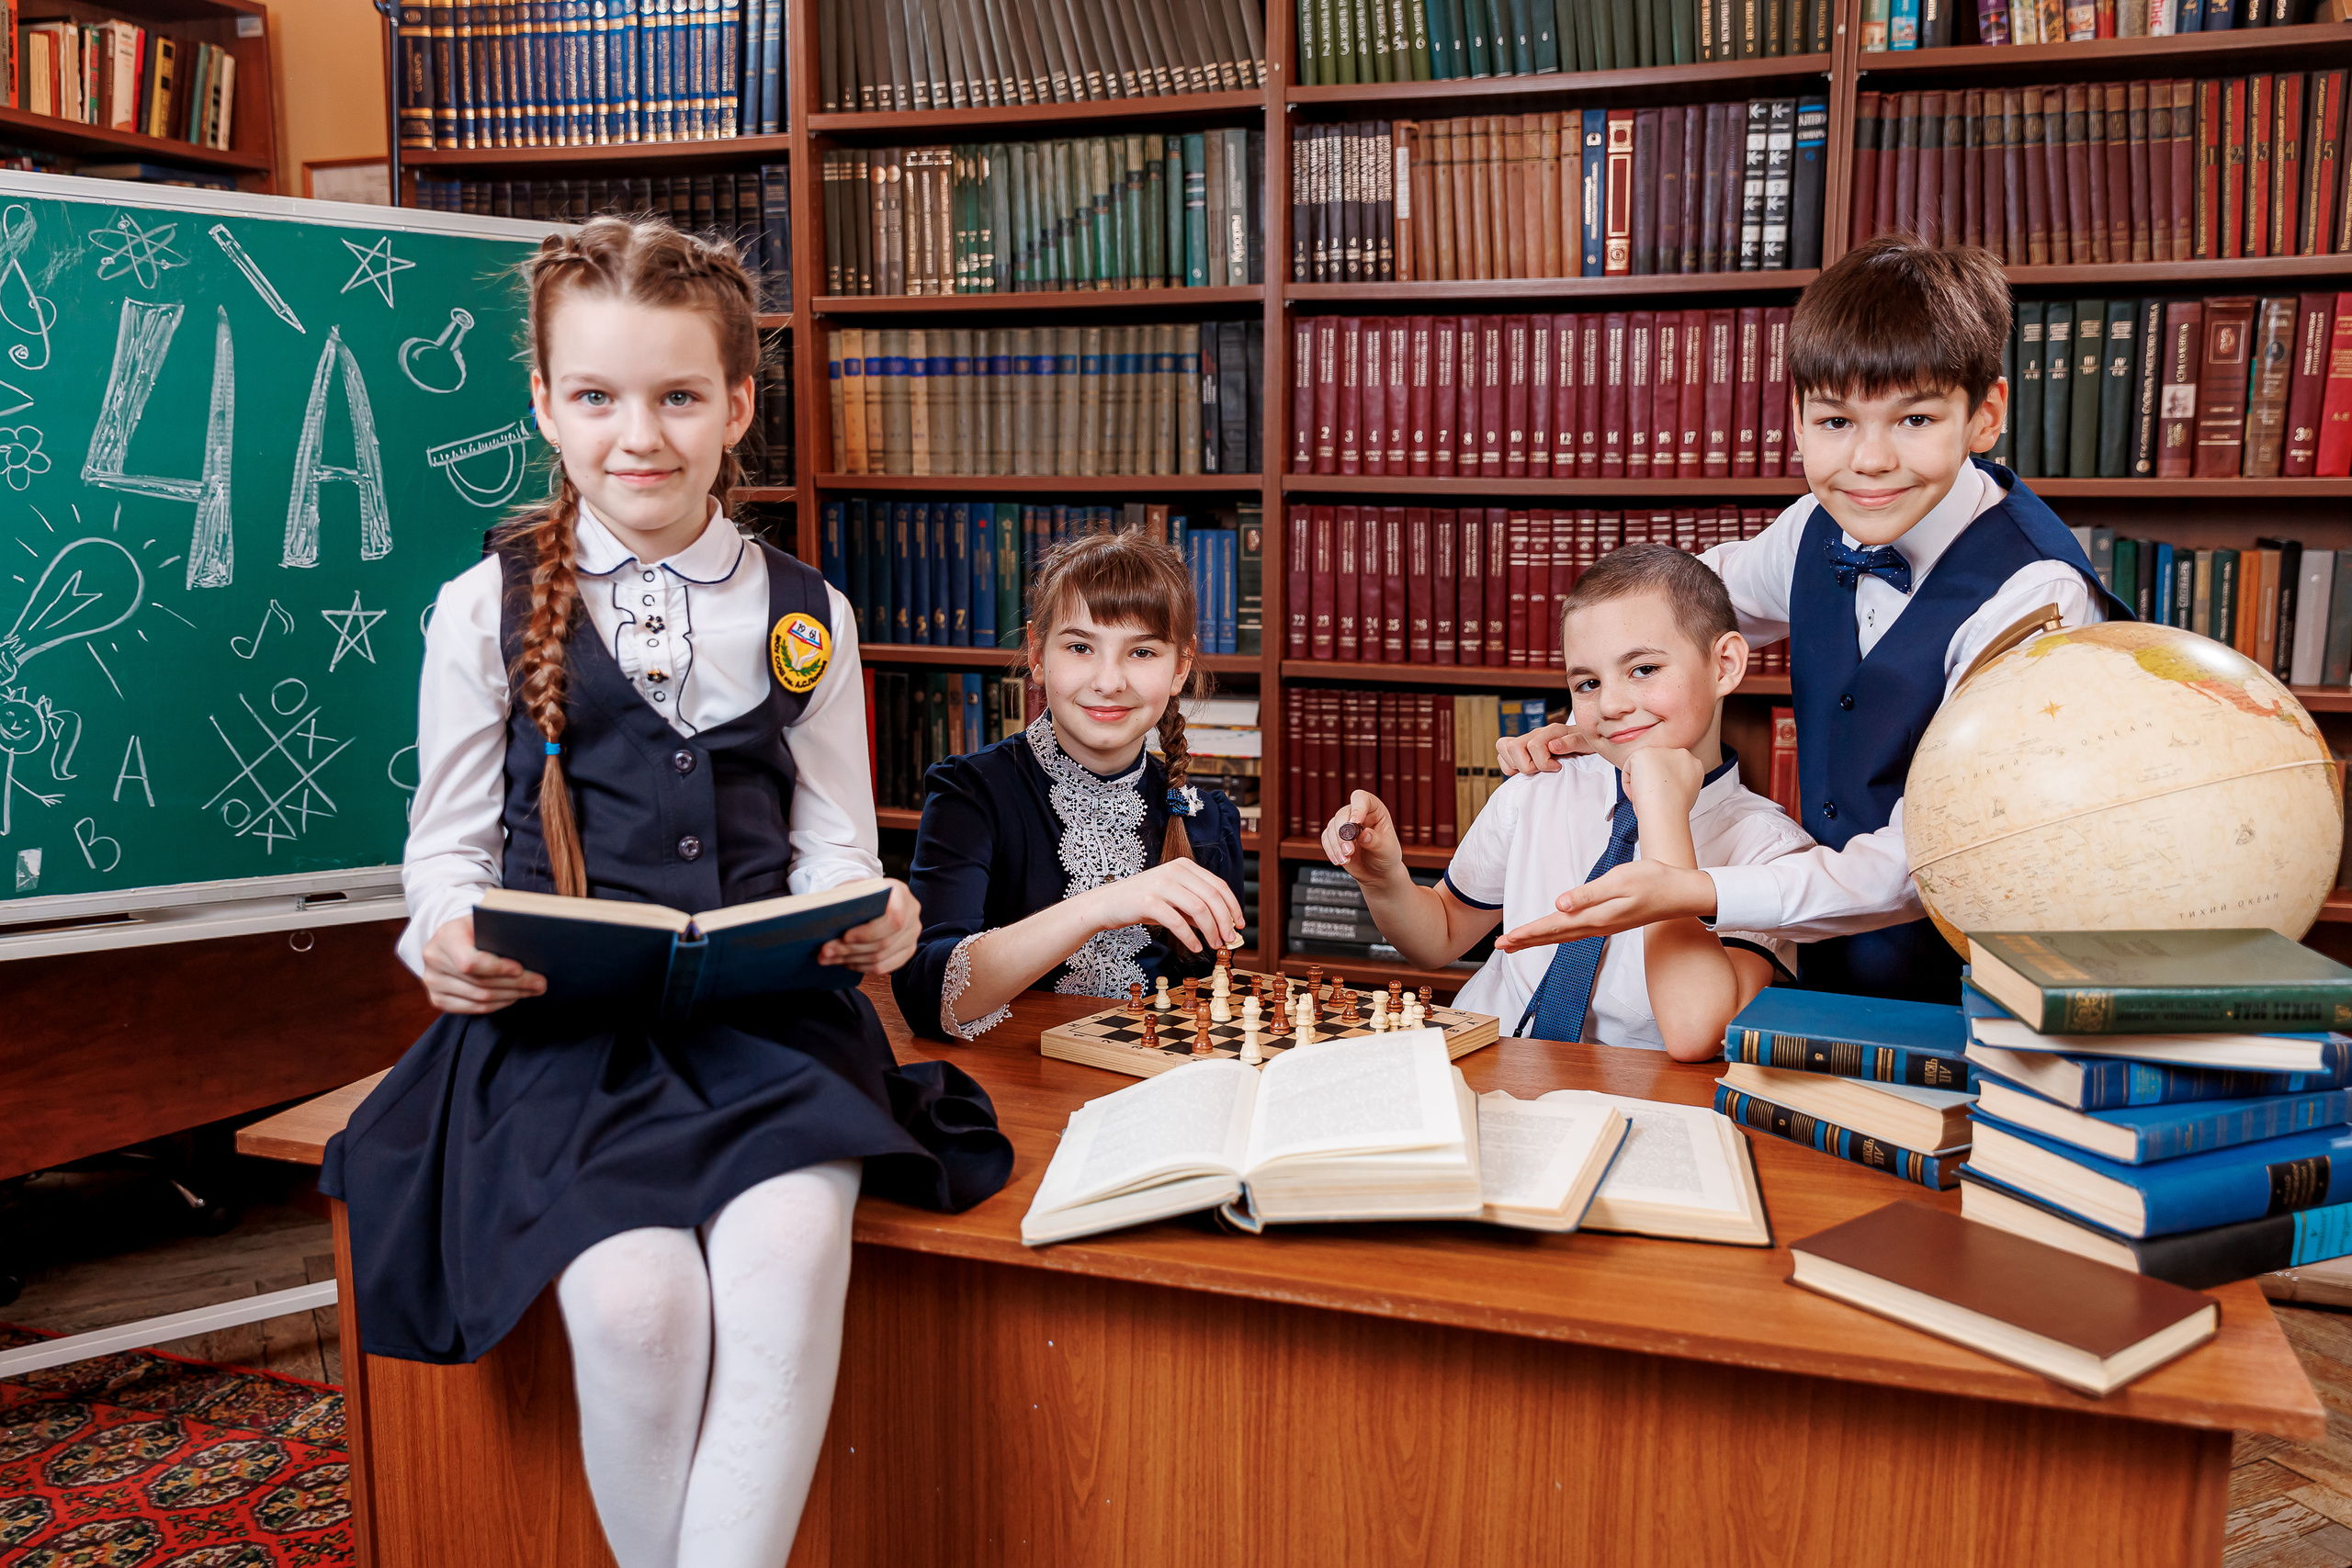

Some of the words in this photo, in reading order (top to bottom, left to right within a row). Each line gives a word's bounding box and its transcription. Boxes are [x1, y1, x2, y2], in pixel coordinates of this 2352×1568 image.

[1323, 42, 1331, 56] 2
[1340, 39, 1350, 55] 3
[1360, 40, 1367, 55] 4
[1415, 36, 1426, 49] 6
[1306, 45, 1312, 59] 1
[2210, 147, 2214, 165] 1
[2232, 145, 2244, 164] 2
[2259, 141, 2269, 161] 3
[2286, 140, 2295, 160] 4
[2324, 141, 2333, 160] 5
[1775, 184, 1780, 194] 2
[1231, 215, 1245, 263] Курорты
[1298, 241, 1303, 251] 1
[1333, 237, 1338, 248] 3
[1349, 237, 1357, 247] 4
[1366, 238, 1373, 249] 5
[1299, 430, 1305, 443] 1
[1321, 426, 1330, 440] 2
[1344, 430, 1354, 443] 3
[1369, 429, 1378, 443] 4
[1392, 429, 1400, 442] 5
[1413, 429, 1423, 443] 6
[1439, 429, 1447, 443] 7
[1463, 432, 1473, 446] 8
[1486, 430, 1496, 445] 9
[1510, 429, 1523, 443] 10
[1534, 430, 1544, 444] 11
[1560, 432, 1572, 446] 12
[1583, 431, 1594, 445] 13
[1607, 431, 1618, 445] 14
[1633, 431, 1645, 445] 15
[1658, 431, 1671, 444] 16
[1684, 431, 1696, 444] 17
[1711, 430, 1724, 444] 18
[1740, 429, 1753, 443] 19
[1766, 429, 1782, 443] 20
[2294, 426, 2312, 441] 30
[897, 608, 907, 622] 4
[935, 608, 945, 624] 6
[956, 609, 966, 625] 7
[1292, 614, 1306, 626] 22
[1316, 615, 1330, 627] 23
[797, 624, 806, 632] 19
[917, 615, 927, 631] 5
[1341, 616, 1353, 629] 24
[1365, 616, 1378, 629] 24
[1386, 619, 1400, 632] 25
[1413, 619, 1427, 632] 26
[1438, 620, 1451, 633] 27
[1464, 620, 1479, 633] 28
[1489, 620, 1503, 633] 29
[1962, 759, 2019, 783] ТИХИЙ
[2081, 722, 2152, 746] ОКЕАН
[113, 735, 155, 807] A
[74, 817, 122, 872] B
[2179, 903, 2227, 920] ТИХИЙ
[2238, 892, 2280, 908] ОКЕАН
